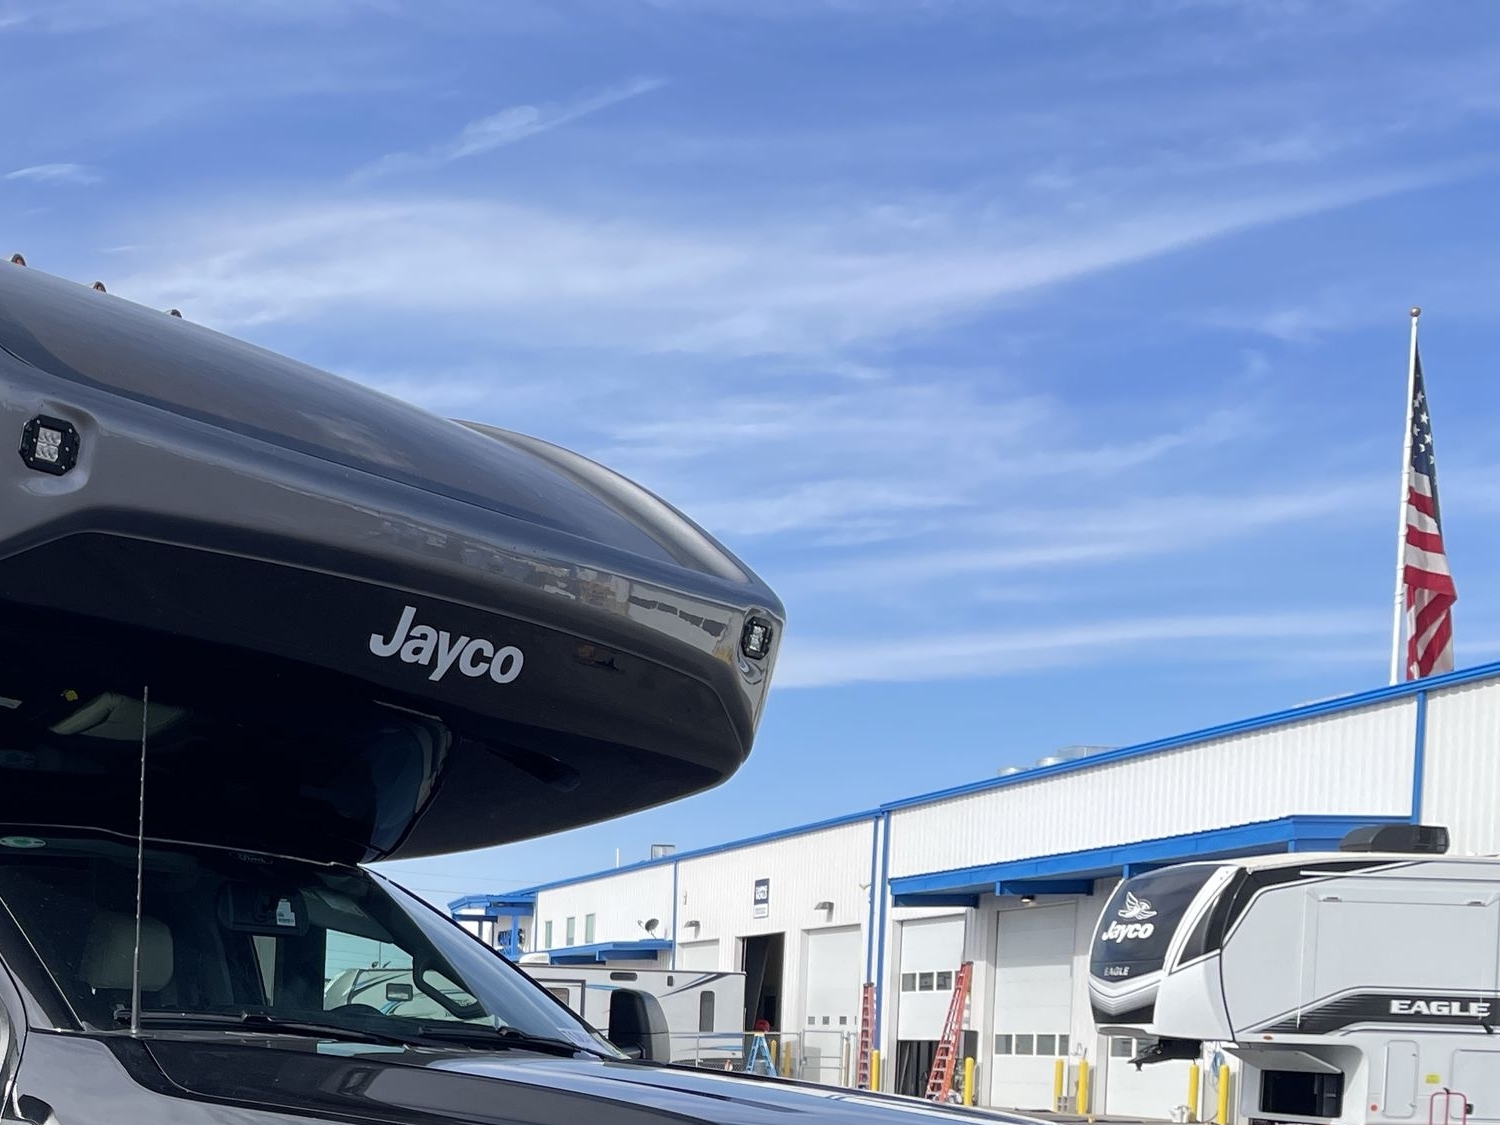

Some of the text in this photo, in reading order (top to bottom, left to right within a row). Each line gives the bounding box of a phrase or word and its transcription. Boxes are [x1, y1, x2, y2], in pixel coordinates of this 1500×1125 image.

[369, 605, 524, 684] Jayco
[1102, 921, 1155, 943] Jayco
[1103, 966, 1130, 977] EAGLE
[1390, 999, 1491, 1018] EAGLE
